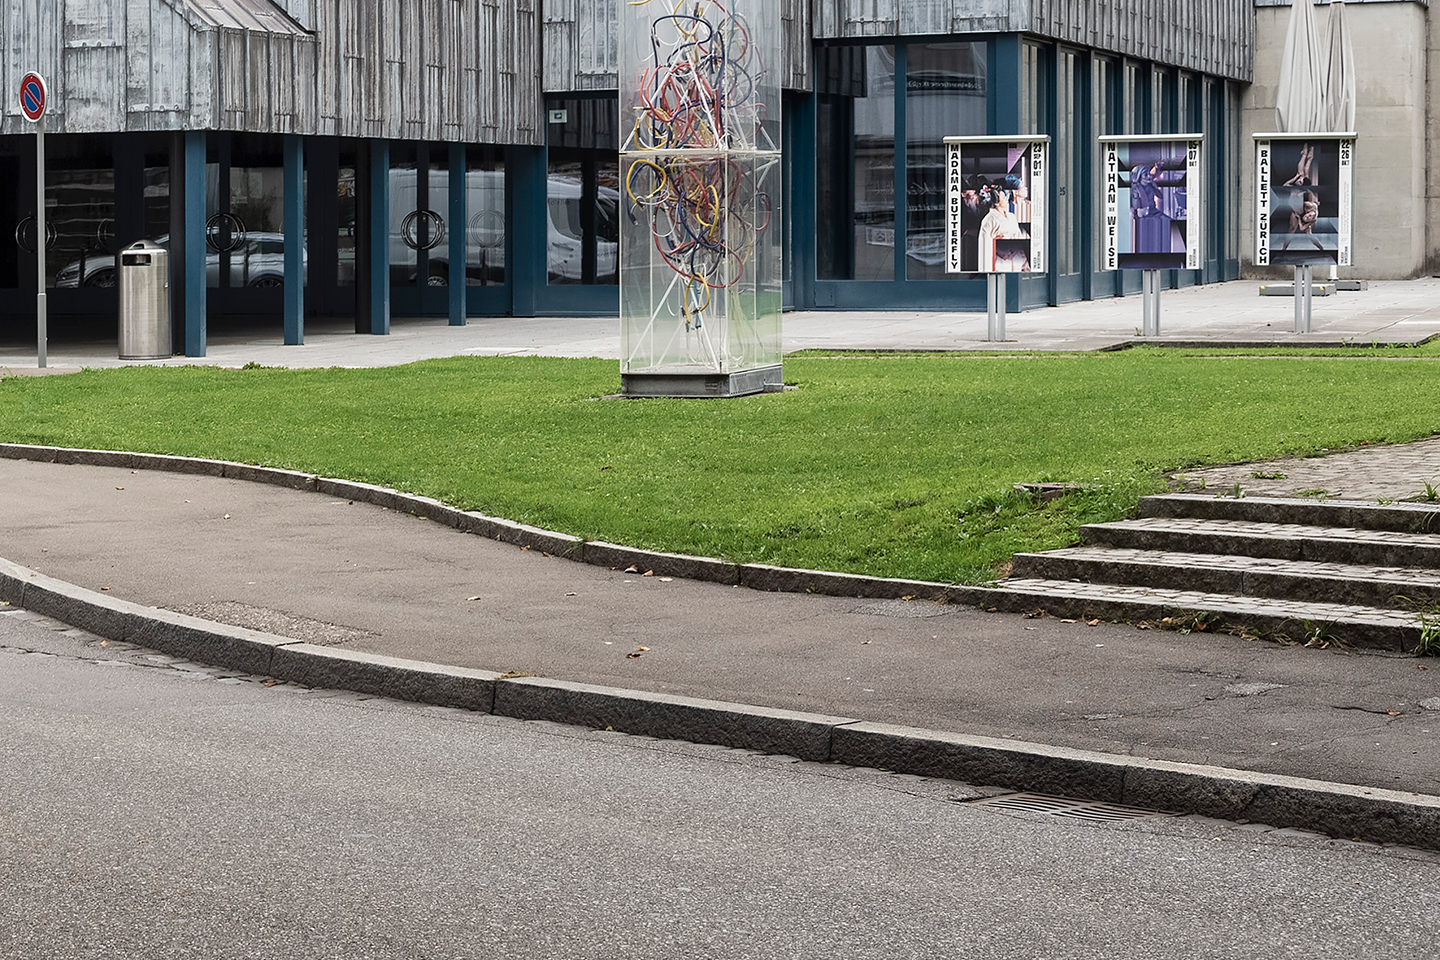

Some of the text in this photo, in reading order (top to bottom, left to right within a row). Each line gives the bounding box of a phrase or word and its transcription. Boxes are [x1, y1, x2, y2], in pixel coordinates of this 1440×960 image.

[1033, 143, 1042, 153] 23
[1188, 150, 1197, 160] 07
[1341, 139, 1350, 149] 22
[1341, 149, 1350, 159] 26
[1033, 160, 1042, 170] 01
[1107, 142, 1116, 203] NATHAN
[1260, 150, 1268, 207] BALLETT
[950, 144, 959, 269] MADAMA BUTTERFLY
[1107, 216, 1116, 267] WEISE
[1259, 213, 1268, 264] ZÜRICH
